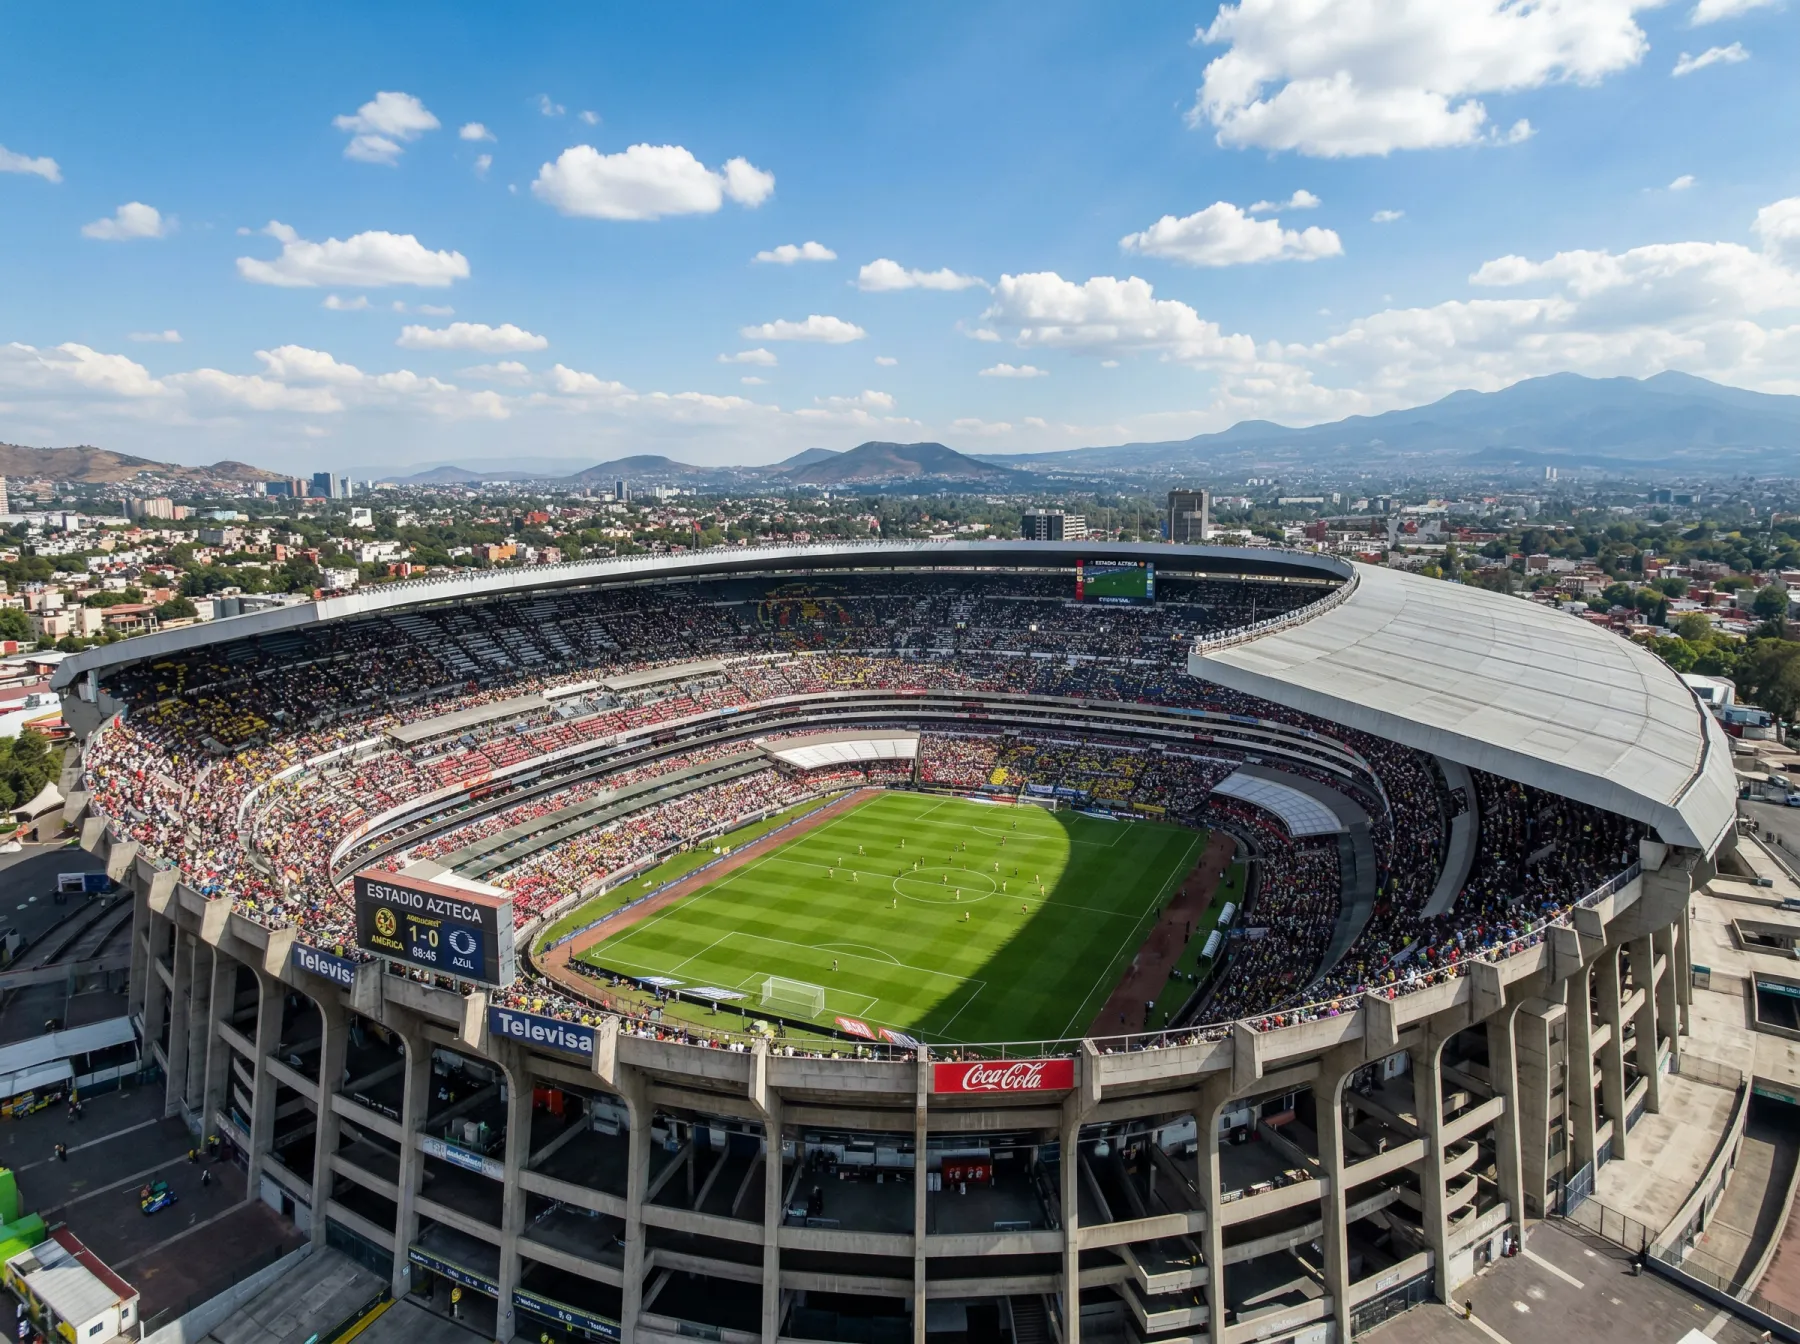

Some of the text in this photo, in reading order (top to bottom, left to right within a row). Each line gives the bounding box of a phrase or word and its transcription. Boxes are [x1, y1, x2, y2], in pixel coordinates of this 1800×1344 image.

[367, 883, 423, 908] ESTADIO
[426, 898, 482, 923] AZTECA
[409, 925, 439, 947] 1-0
[412, 946, 437, 961] 68:45
[452, 956, 474, 969] AZUL
[499, 1013, 592, 1052] Televisa
[962, 1062, 1047, 1090] Coca-Cola
